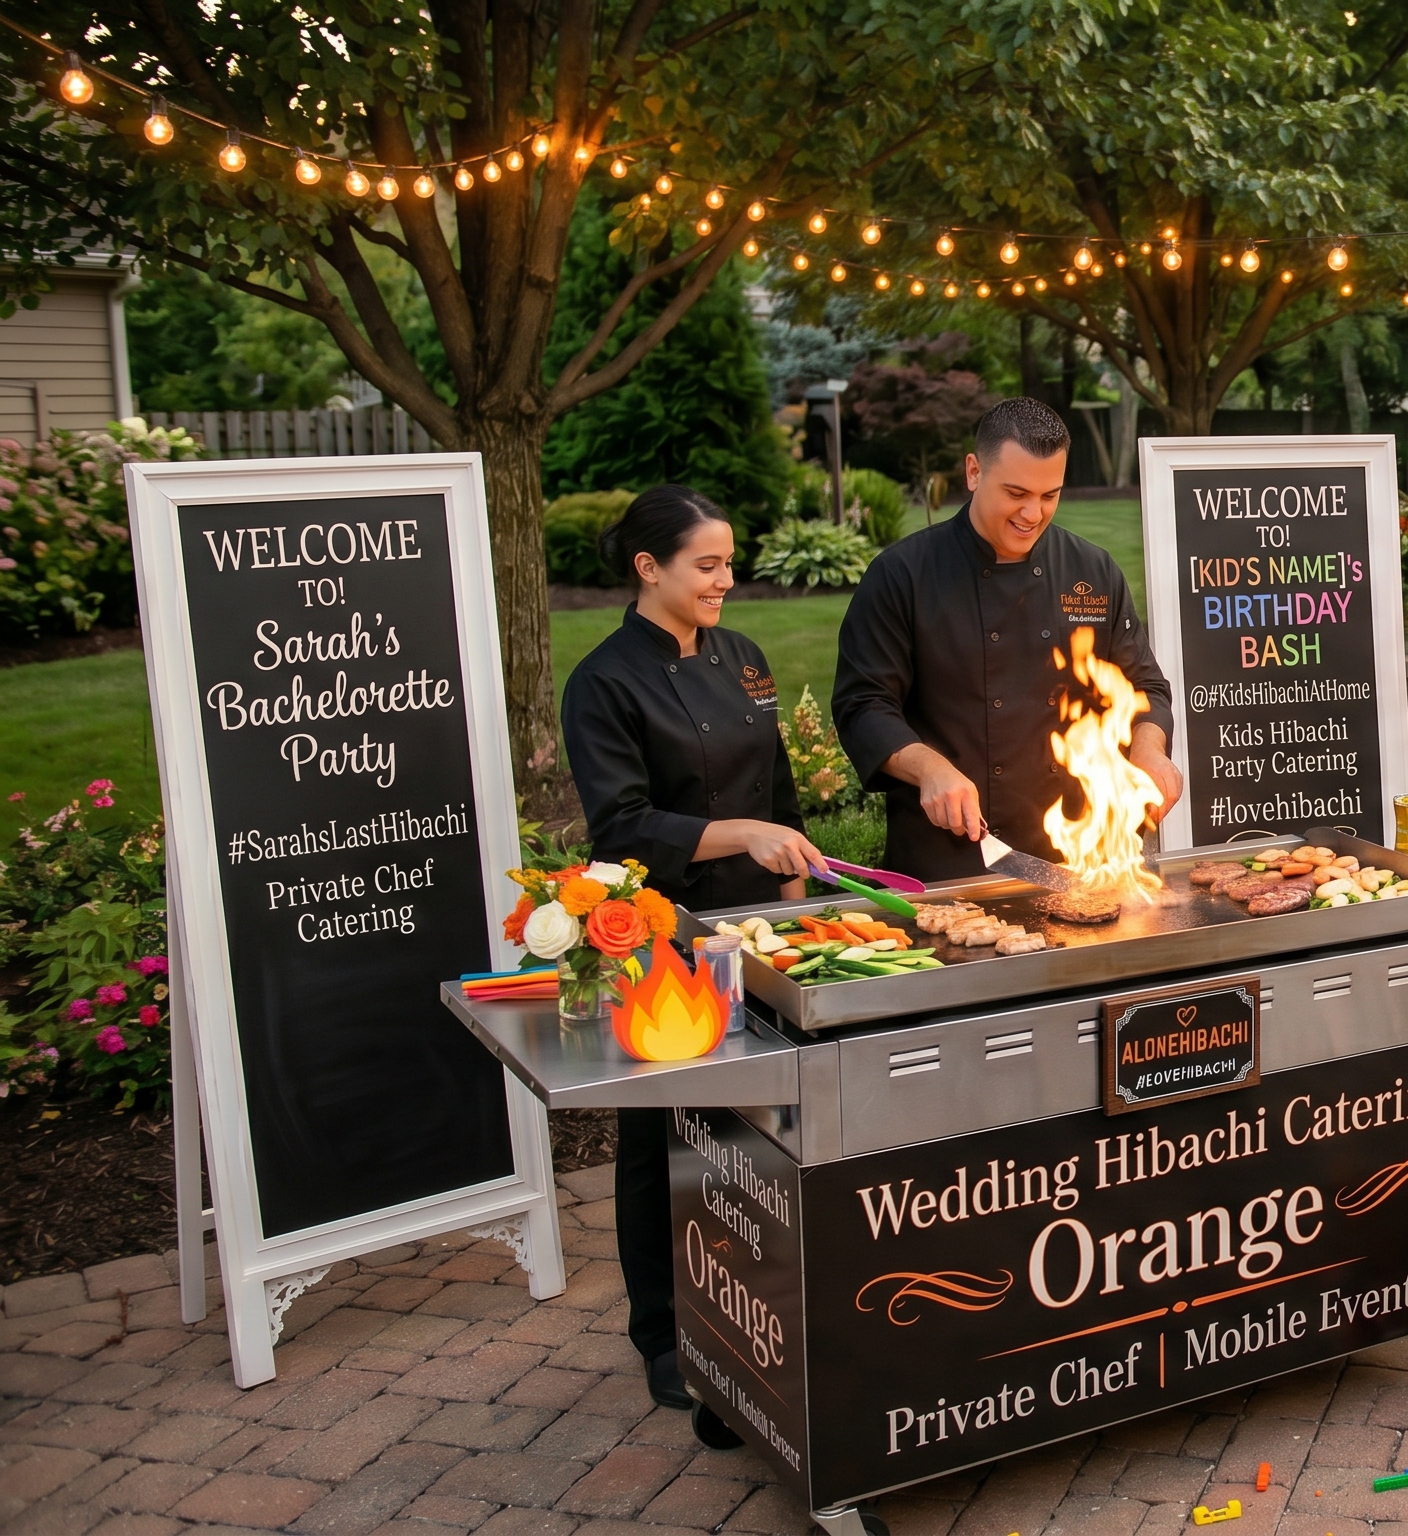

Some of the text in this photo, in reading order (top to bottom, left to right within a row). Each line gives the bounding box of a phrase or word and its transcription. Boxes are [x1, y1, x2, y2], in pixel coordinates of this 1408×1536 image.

[1193, 485, 1348, 520] WELCOME
[203, 520, 422, 572] WELCOME
[1256, 525, 1291, 548] TO!
[298, 577, 347, 607] TO!
[1190, 551, 1363, 593] [KID'S NAME]'s
[1204, 591, 1352, 630] BIRTHDAY
[253, 612, 401, 671] Sarah's
[1240, 633, 1321, 668] BASH
[206, 669, 454, 731] Bachelorette
[1190, 678, 1370, 713] @#KidsHibachiAtHome
[1218, 717, 1348, 748] Kids Hibachi
[281, 733, 396, 789] Party
[1211, 749, 1357, 782] Party Catering
[1210, 788, 1363, 827] #lovehibachi
[228, 804, 469, 865] #SarahsLastHibachi
[266, 858, 436, 910] Private Chef
[297, 903, 415, 943] Catering
[1121, 1020, 1248, 1065] ALONEHIBACHI
[733, 1145, 790, 1228] Hibachi
[857, 1156, 1080, 1240] Wedding
[1096, 1106, 1268, 1190] Hibachi
[702, 1172, 762, 1261] Catering
[1028, 1184, 1325, 1310] Orange
[686, 1219, 784, 1368] Orange
[886, 1379, 1036, 1456] Private
[1050, 1341, 1142, 1406] Chef
[1183, 1302, 1307, 1372] Mobile
